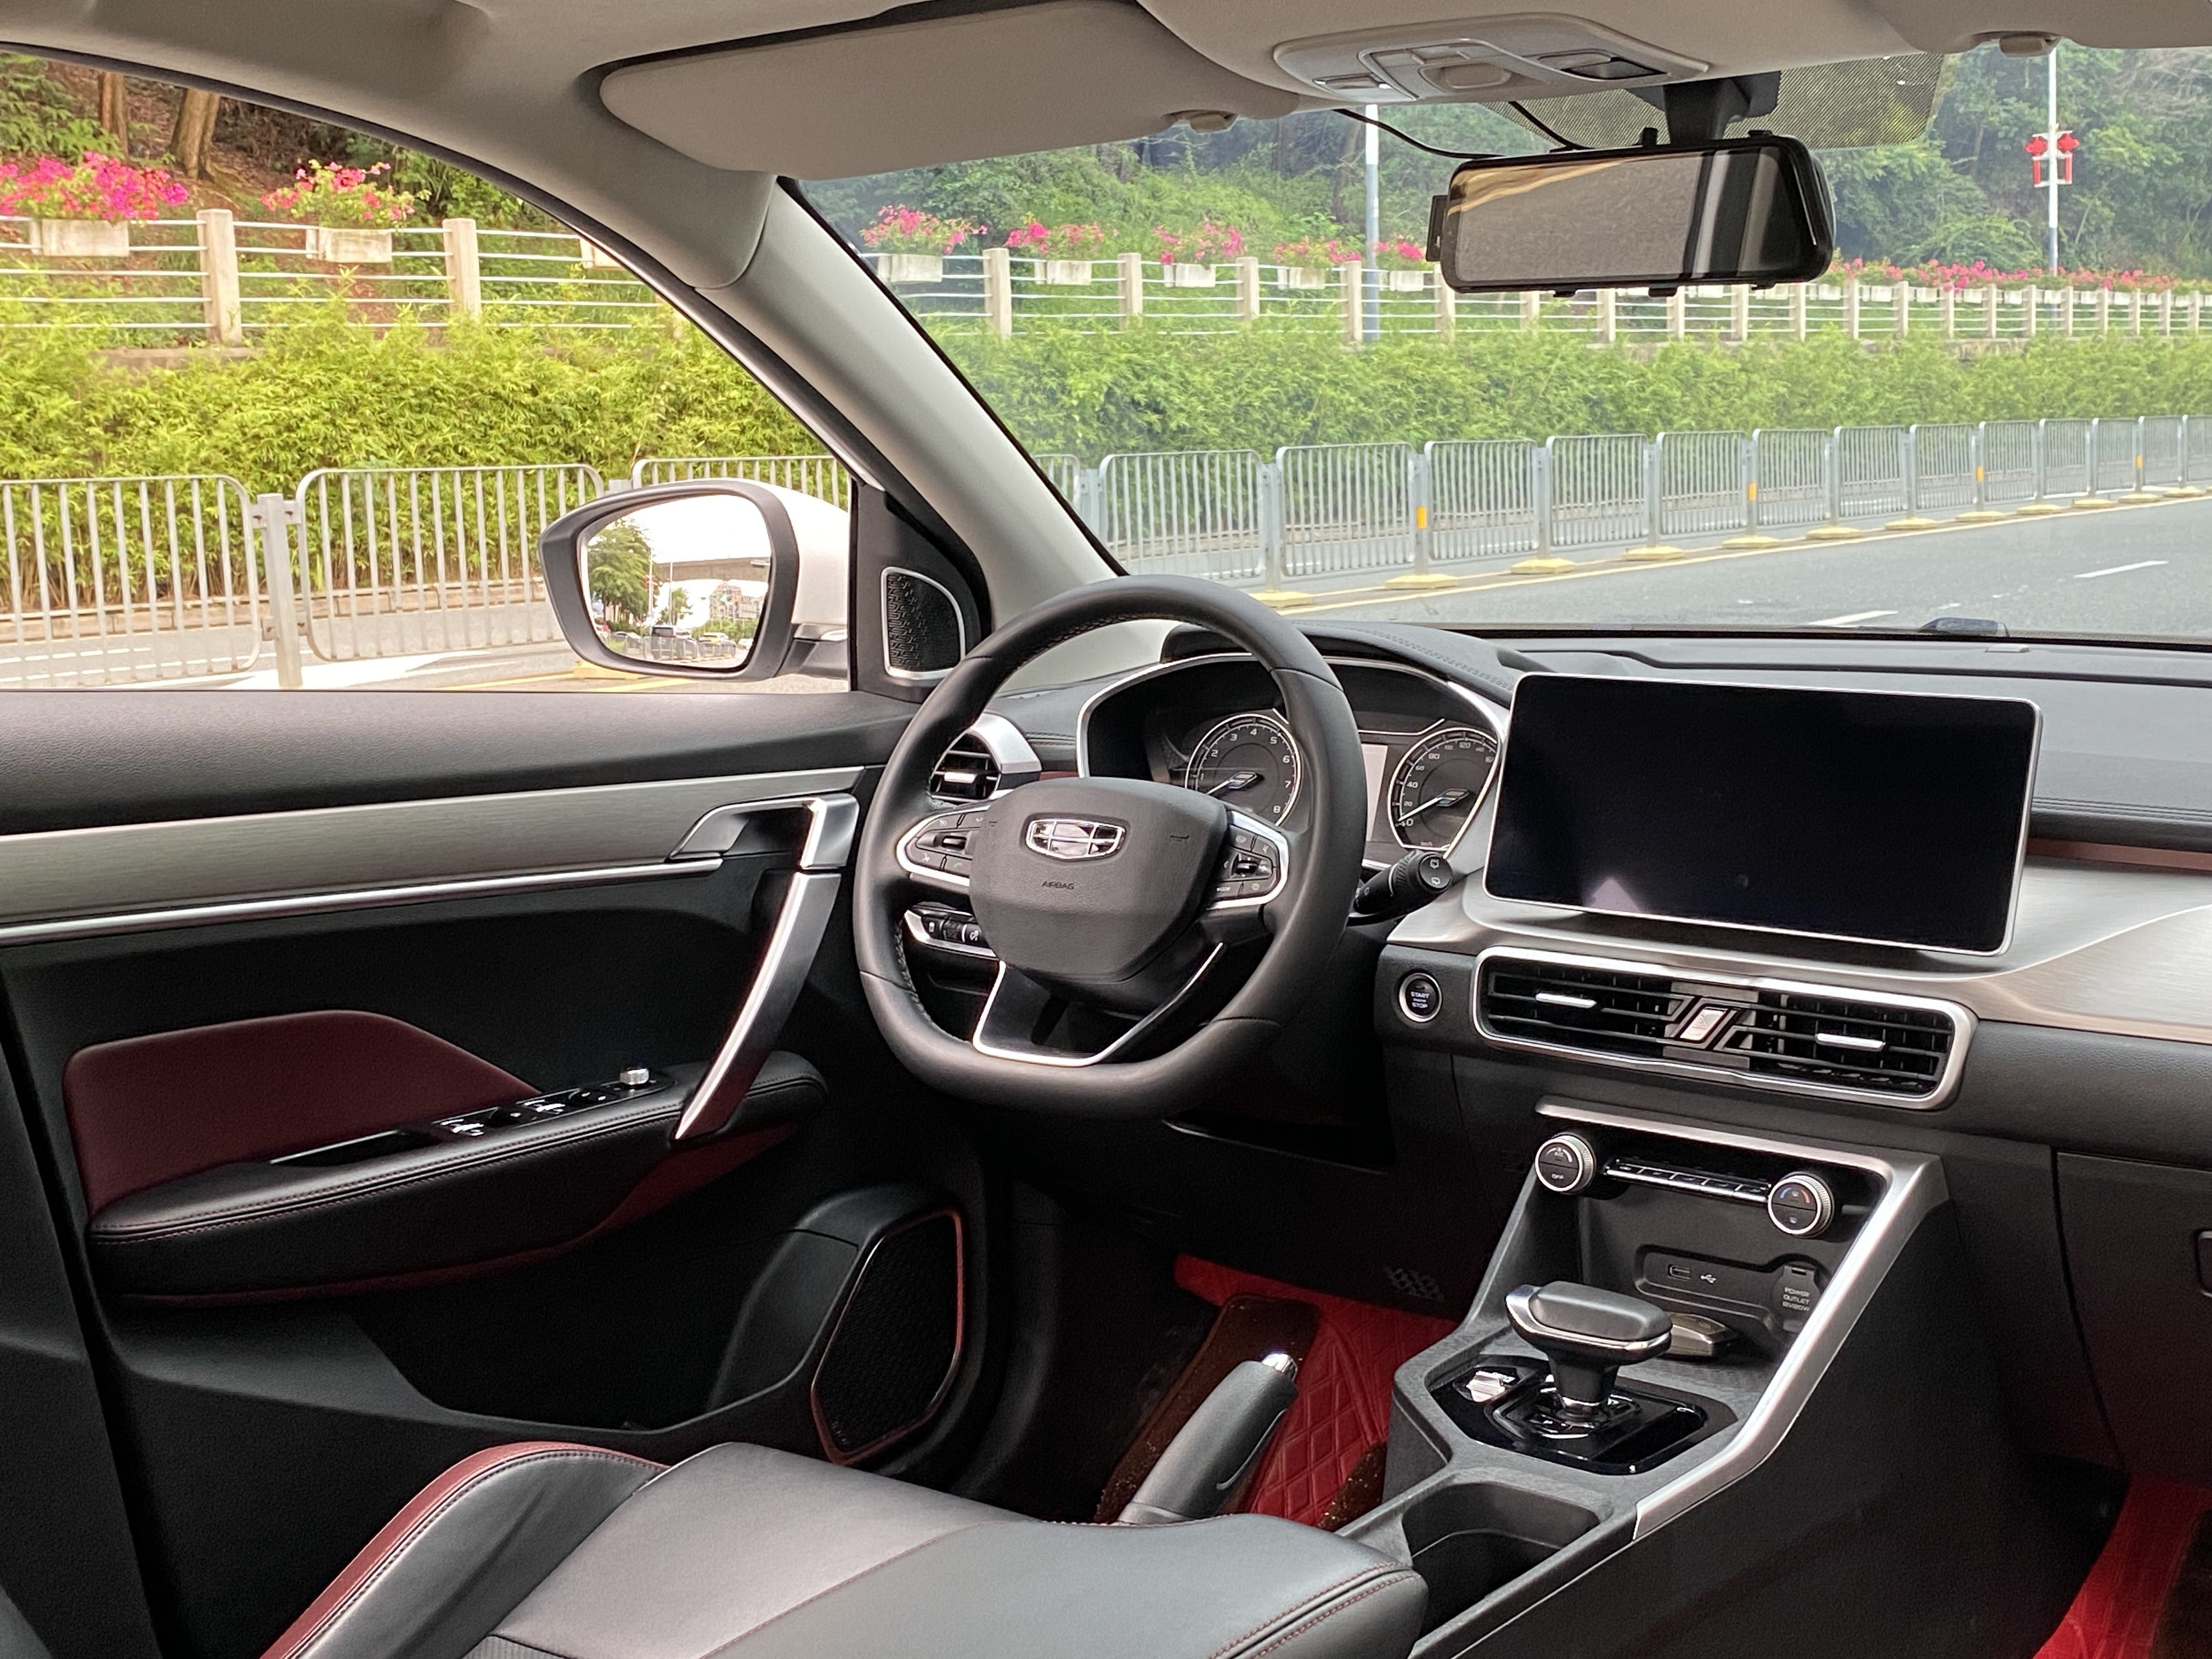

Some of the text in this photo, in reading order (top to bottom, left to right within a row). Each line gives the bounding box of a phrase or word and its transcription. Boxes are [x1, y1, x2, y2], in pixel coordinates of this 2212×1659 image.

[1283, 755, 1290, 763] 6
[1406, 818, 1414, 827] 0
[1041, 881, 1075, 890] AIRBAG
[1784, 1287, 1809, 1297] POWER
[1783, 1294, 1810, 1305] OUTLET
